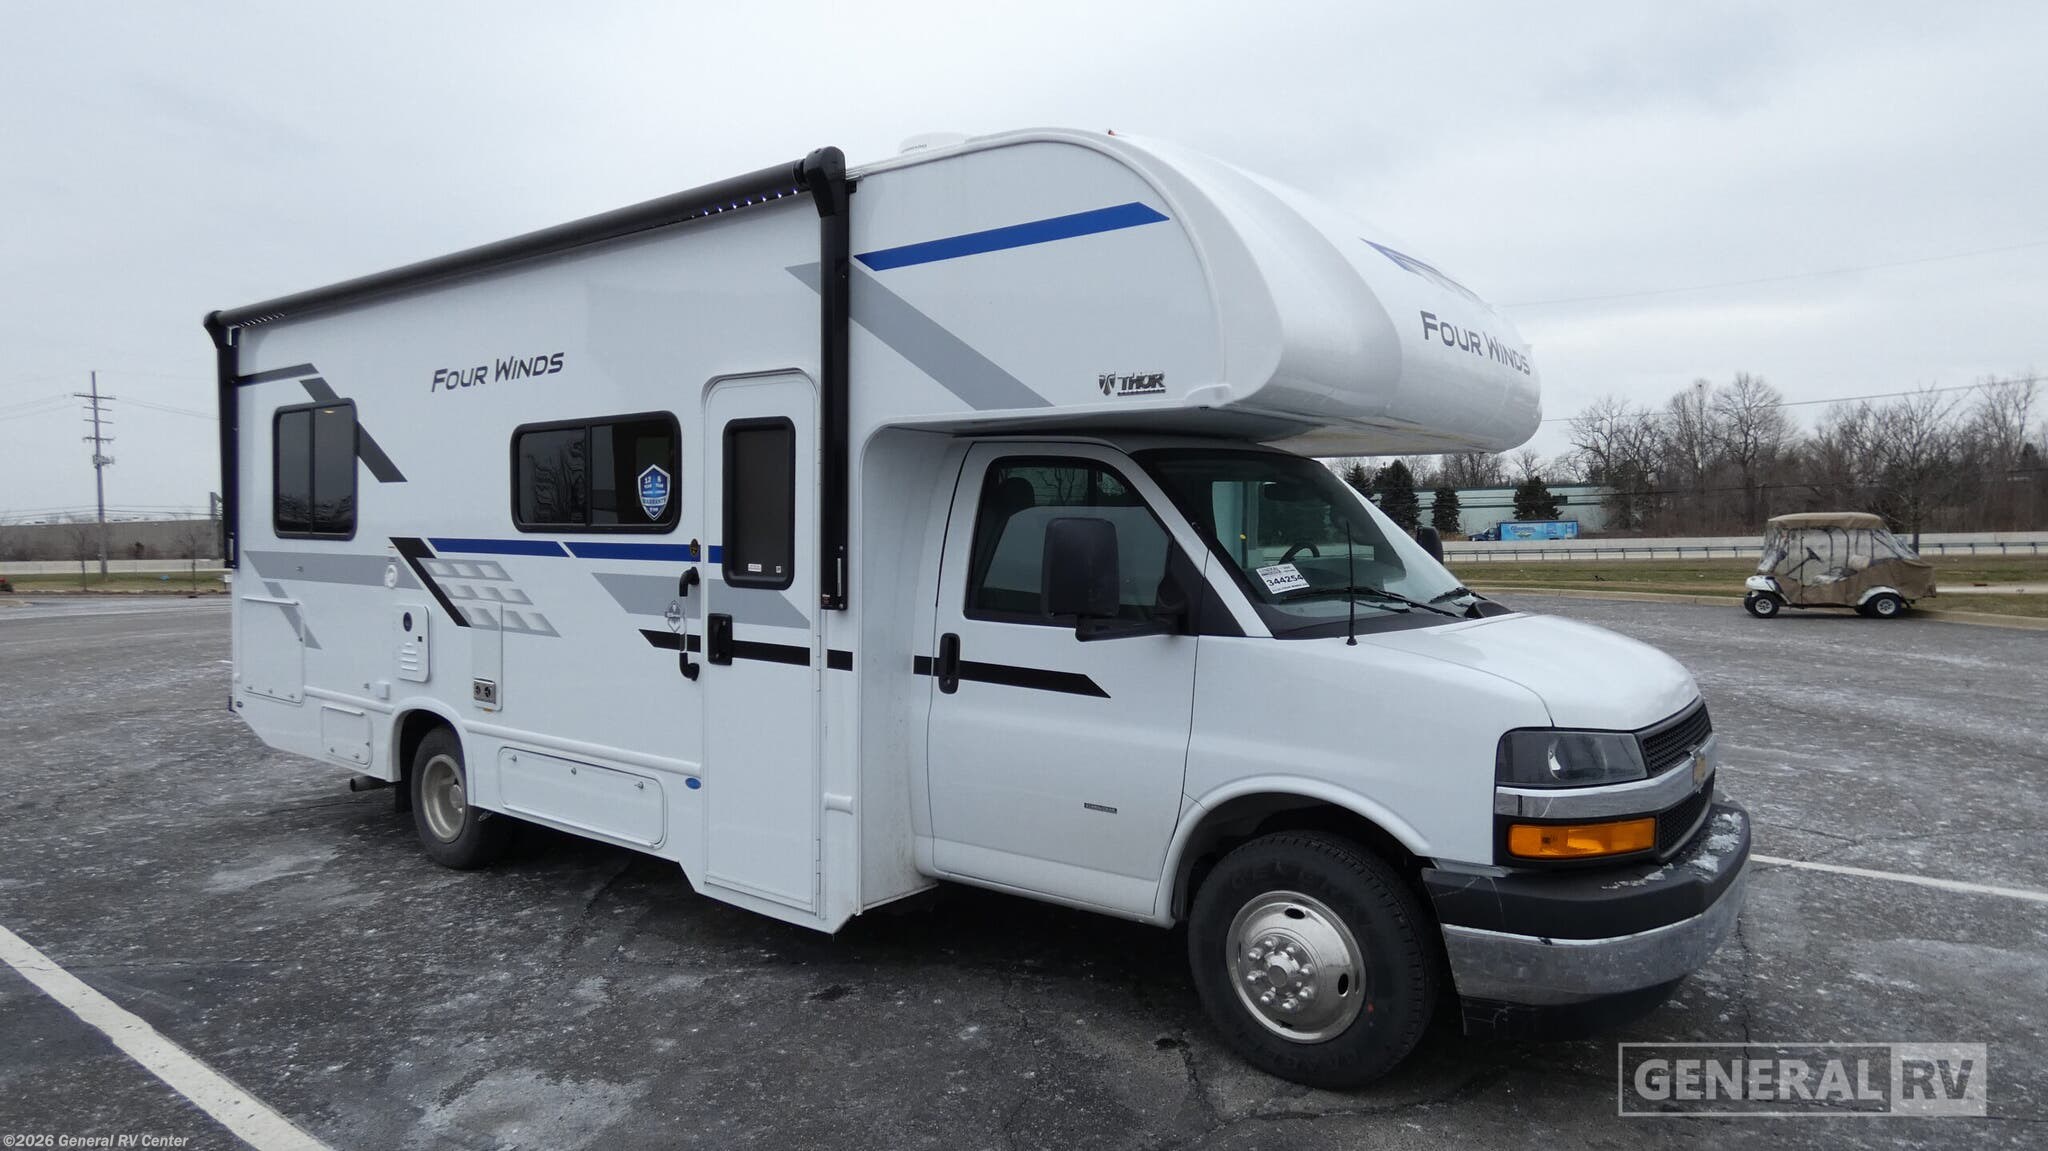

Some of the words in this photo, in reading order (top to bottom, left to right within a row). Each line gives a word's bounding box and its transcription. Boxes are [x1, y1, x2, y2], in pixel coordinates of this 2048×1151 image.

[1420, 310, 1483, 356] FOUR
[1483, 331, 1531, 376] WINDS
[431, 366, 488, 393] FOUR
[495, 352, 565, 382] WINDS
[1117, 373, 1166, 391] THOR
[1266, 574, 1304, 587] 344254
